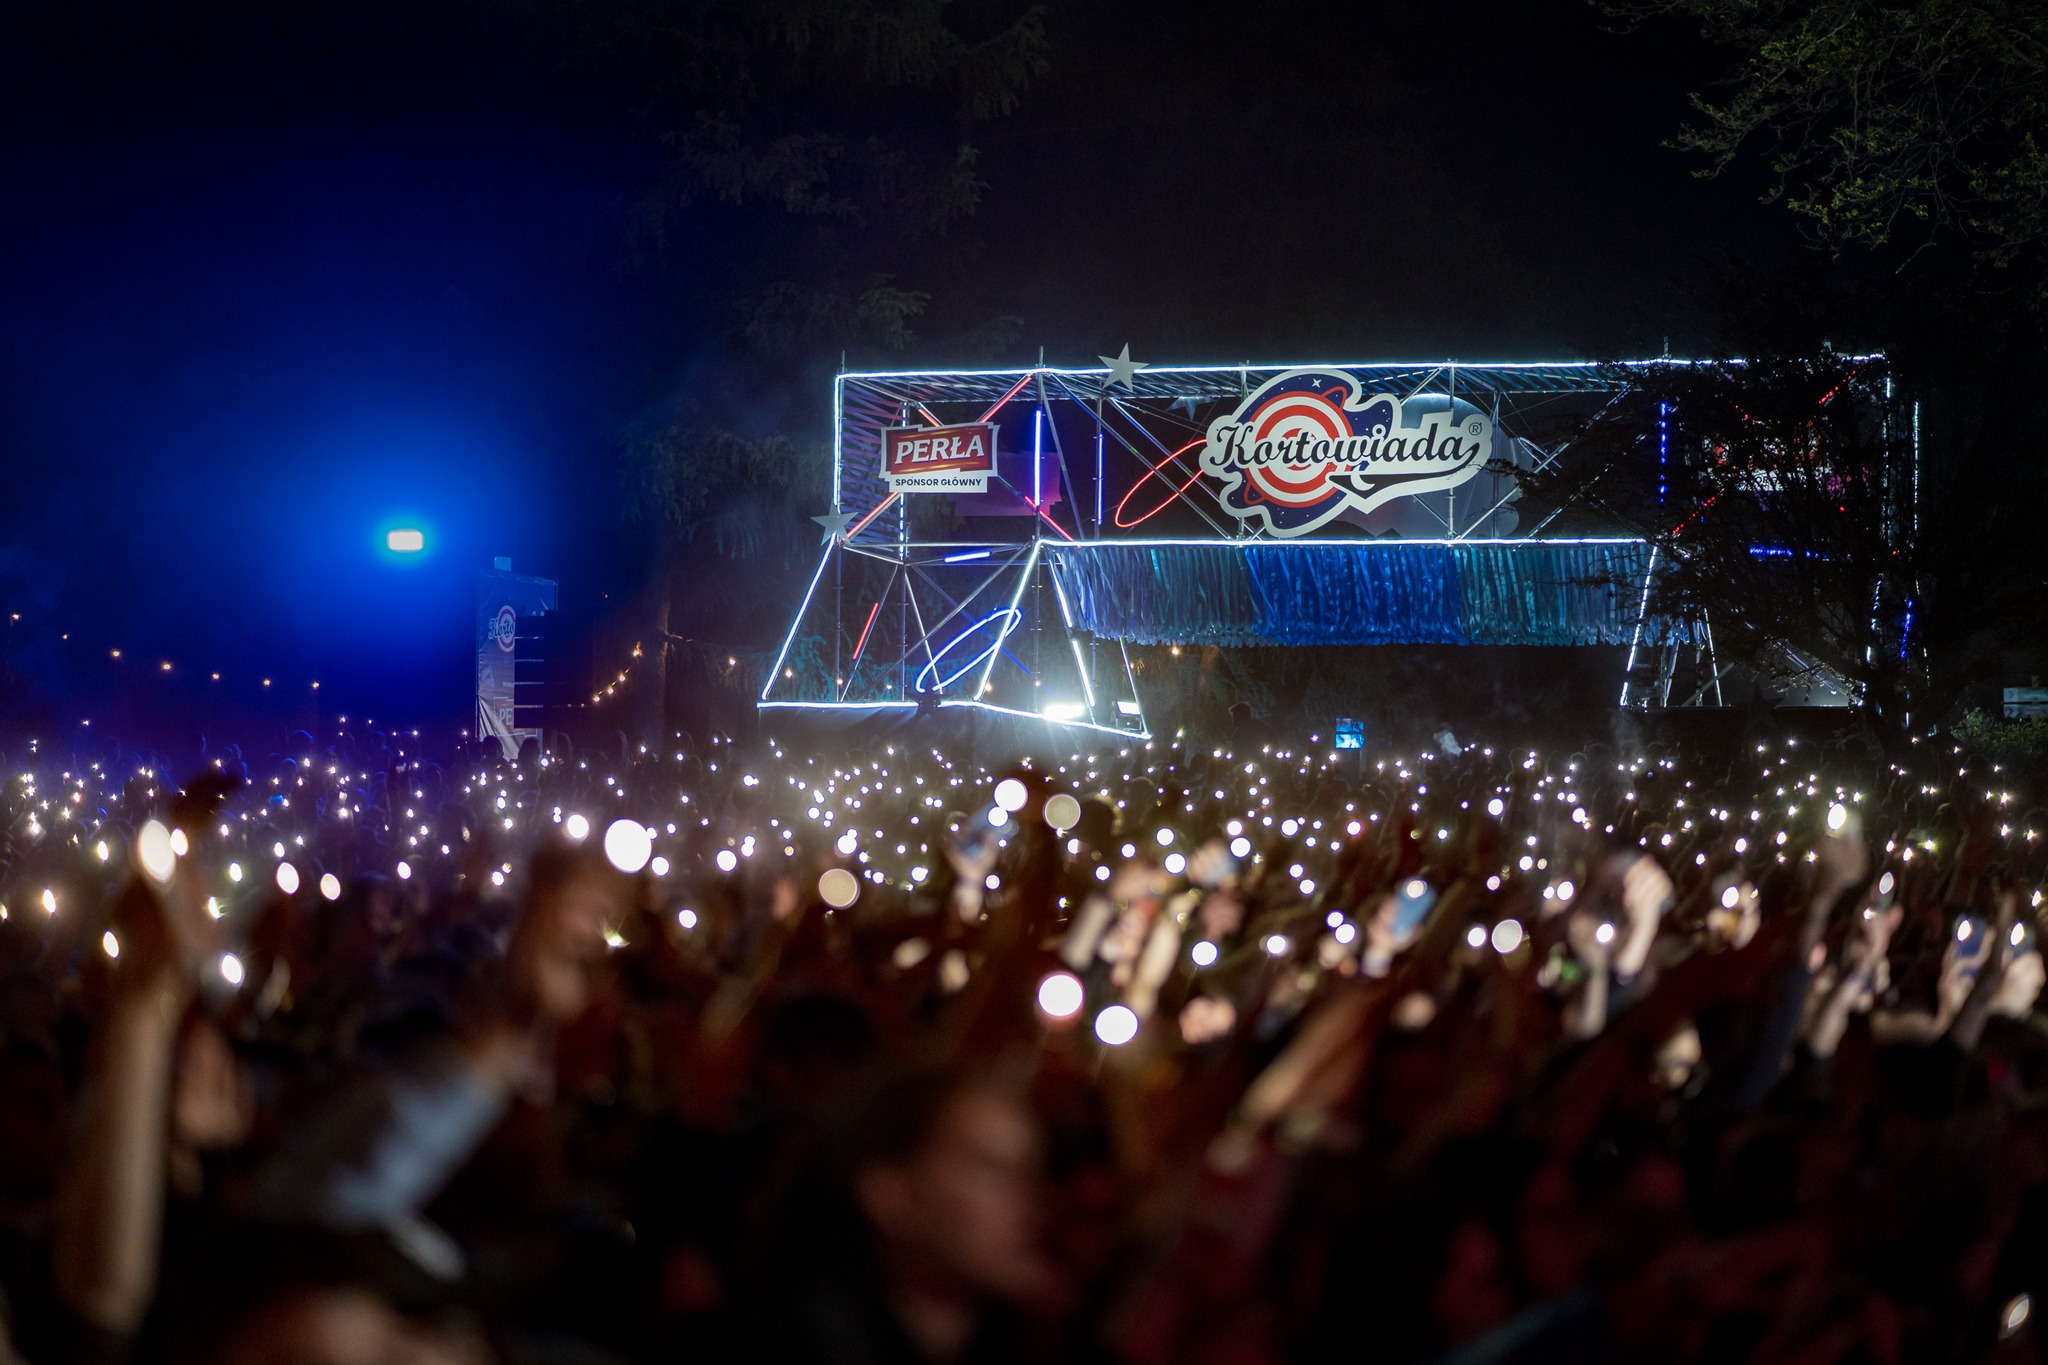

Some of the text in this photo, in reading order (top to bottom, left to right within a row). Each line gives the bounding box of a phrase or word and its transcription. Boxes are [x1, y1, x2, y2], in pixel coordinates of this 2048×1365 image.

[895, 436, 984, 464] PERŁA
[1209, 422, 1480, 469] Kortowiada
[895, 476, 982, 487] SPONSOR GŁÓWNY
[489, 619, 515, 638] Korto
